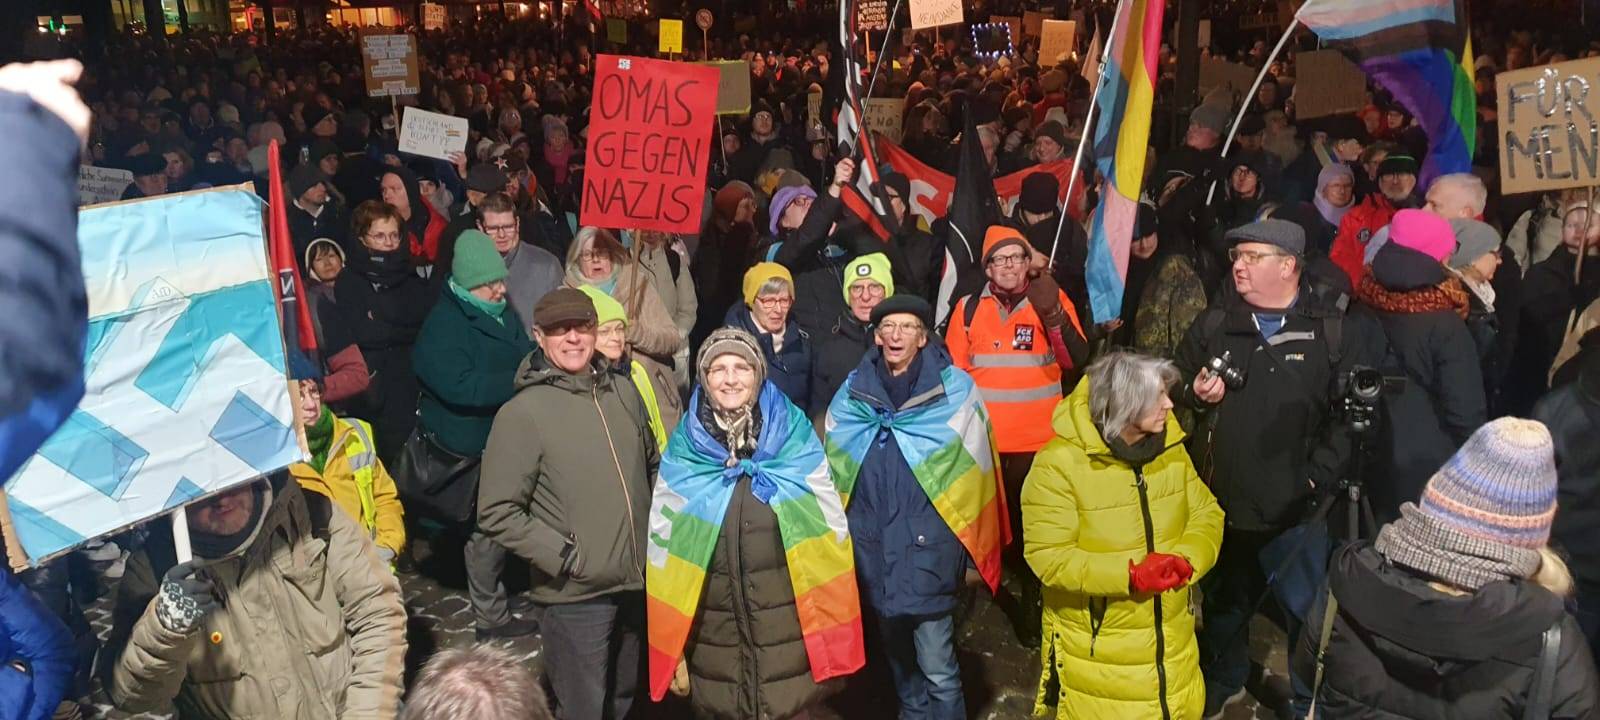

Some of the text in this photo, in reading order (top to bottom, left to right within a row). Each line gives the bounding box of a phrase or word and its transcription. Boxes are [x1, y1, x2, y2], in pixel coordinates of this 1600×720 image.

[600, 74, 699, 126] OMAS
[1508, 68, 1592, 124] FÜR
[594, 131, 701, 177] GEGEN
[1506, 121, 1598, 180] MEN
[584, 178, 694, 223] NAZIS
